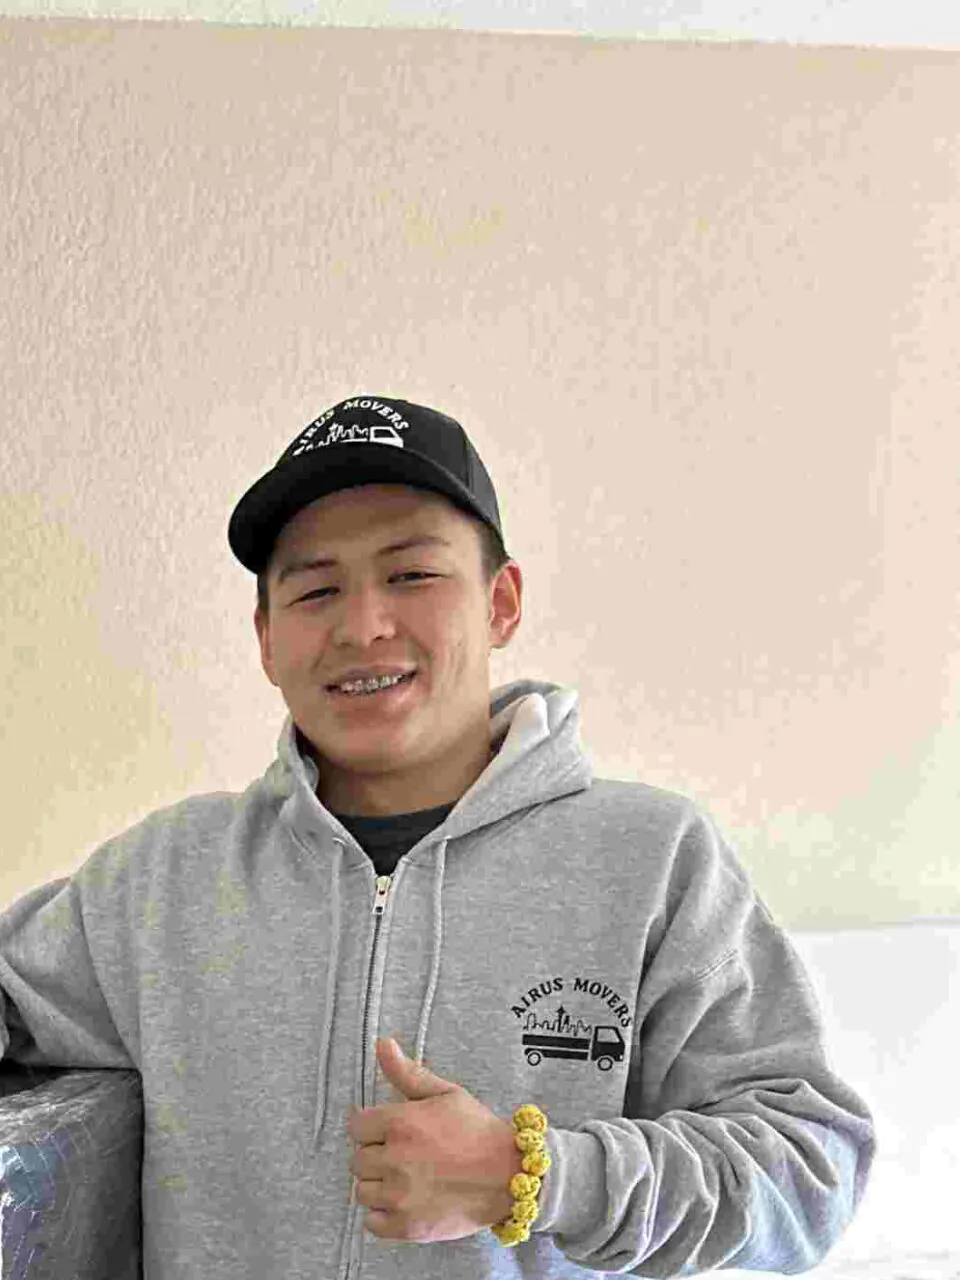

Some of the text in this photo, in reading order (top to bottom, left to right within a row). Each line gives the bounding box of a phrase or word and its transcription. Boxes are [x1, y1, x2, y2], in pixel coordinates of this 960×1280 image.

[343, 399, 409, 430] MOVERS
[510, 977, 633, 1028] AIRUS MOVERS
